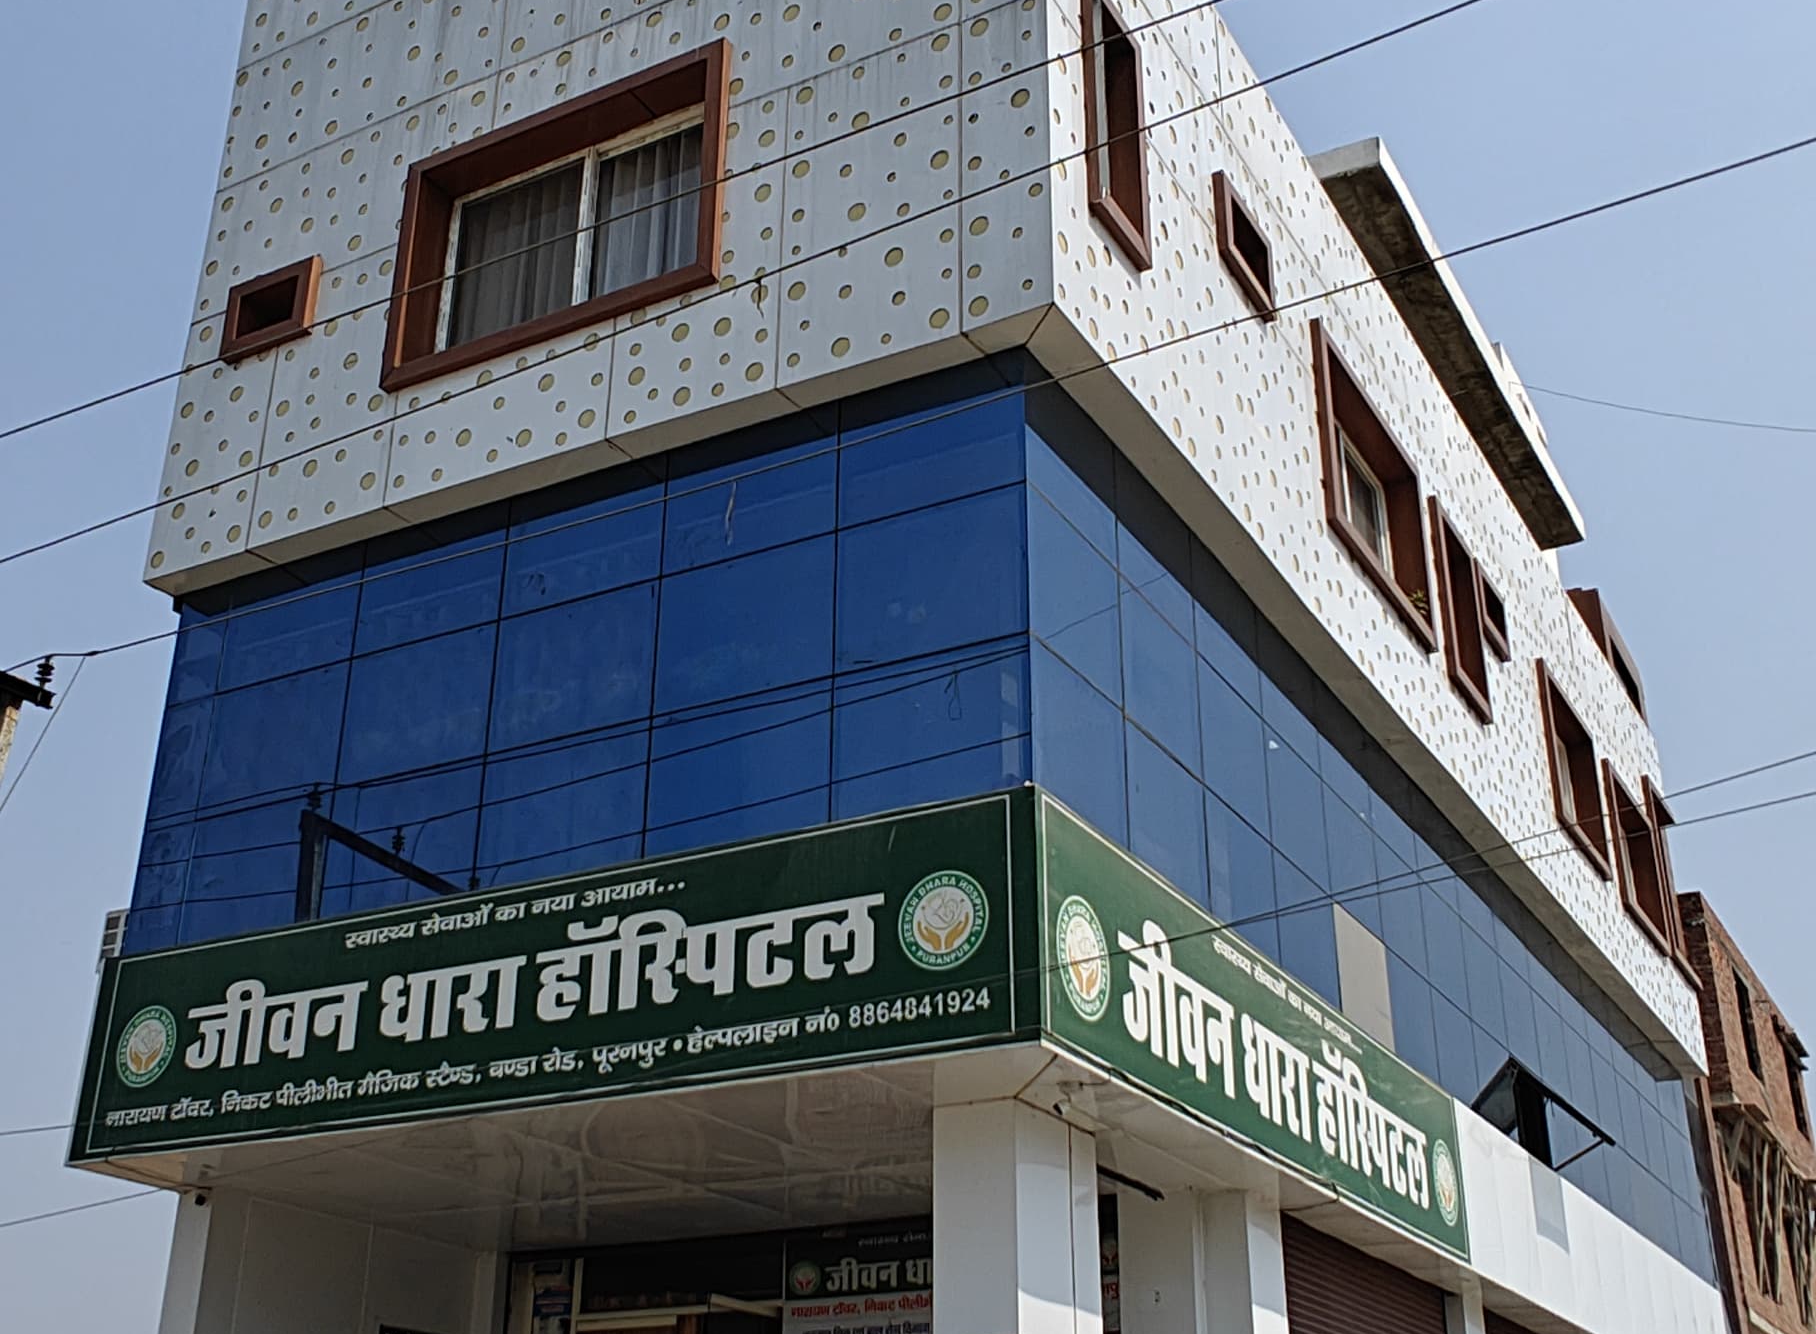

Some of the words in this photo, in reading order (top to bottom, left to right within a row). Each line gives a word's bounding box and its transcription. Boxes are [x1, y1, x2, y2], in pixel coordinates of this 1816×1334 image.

[345, 922, 416, 950] स्वास्थ्य
[421, 902, 491, 936] सेवाओं
[494, 903, 526, 924] का
[531, 892, 577, 916] नया
[918, 876, 956, 897] DHARA
[958, 878, 984, 933] HOSPITAL
[184, 978, 368, 1069] जीवन
[379, 955, 527, 1043] धारा
[535, 893, 885, 1022] हॉस्पिटल
[916, 942, 971, 965] PURANPUR
[105, 1105, 166, 1128] नारायण
[221, 1088, 275, 1114] निकट
[276, 1077, 354, 1109] पीलीभीत
[592, 1037, 668, 1074] पूरनपुर
[687, 1016, 801, 1054] हेल्पलाइन
[848, 987, 991, 1028] 8864841924
[1117, 919, 1235, 1100] जीवन
[1240, 1012, 1312, 1144] धारा
[1312, 1039, 1430, 1210] हॉस्पिटल
[823, 1256, 901, 1292] जीवन
[905, 1257, 932, 1286] धा
